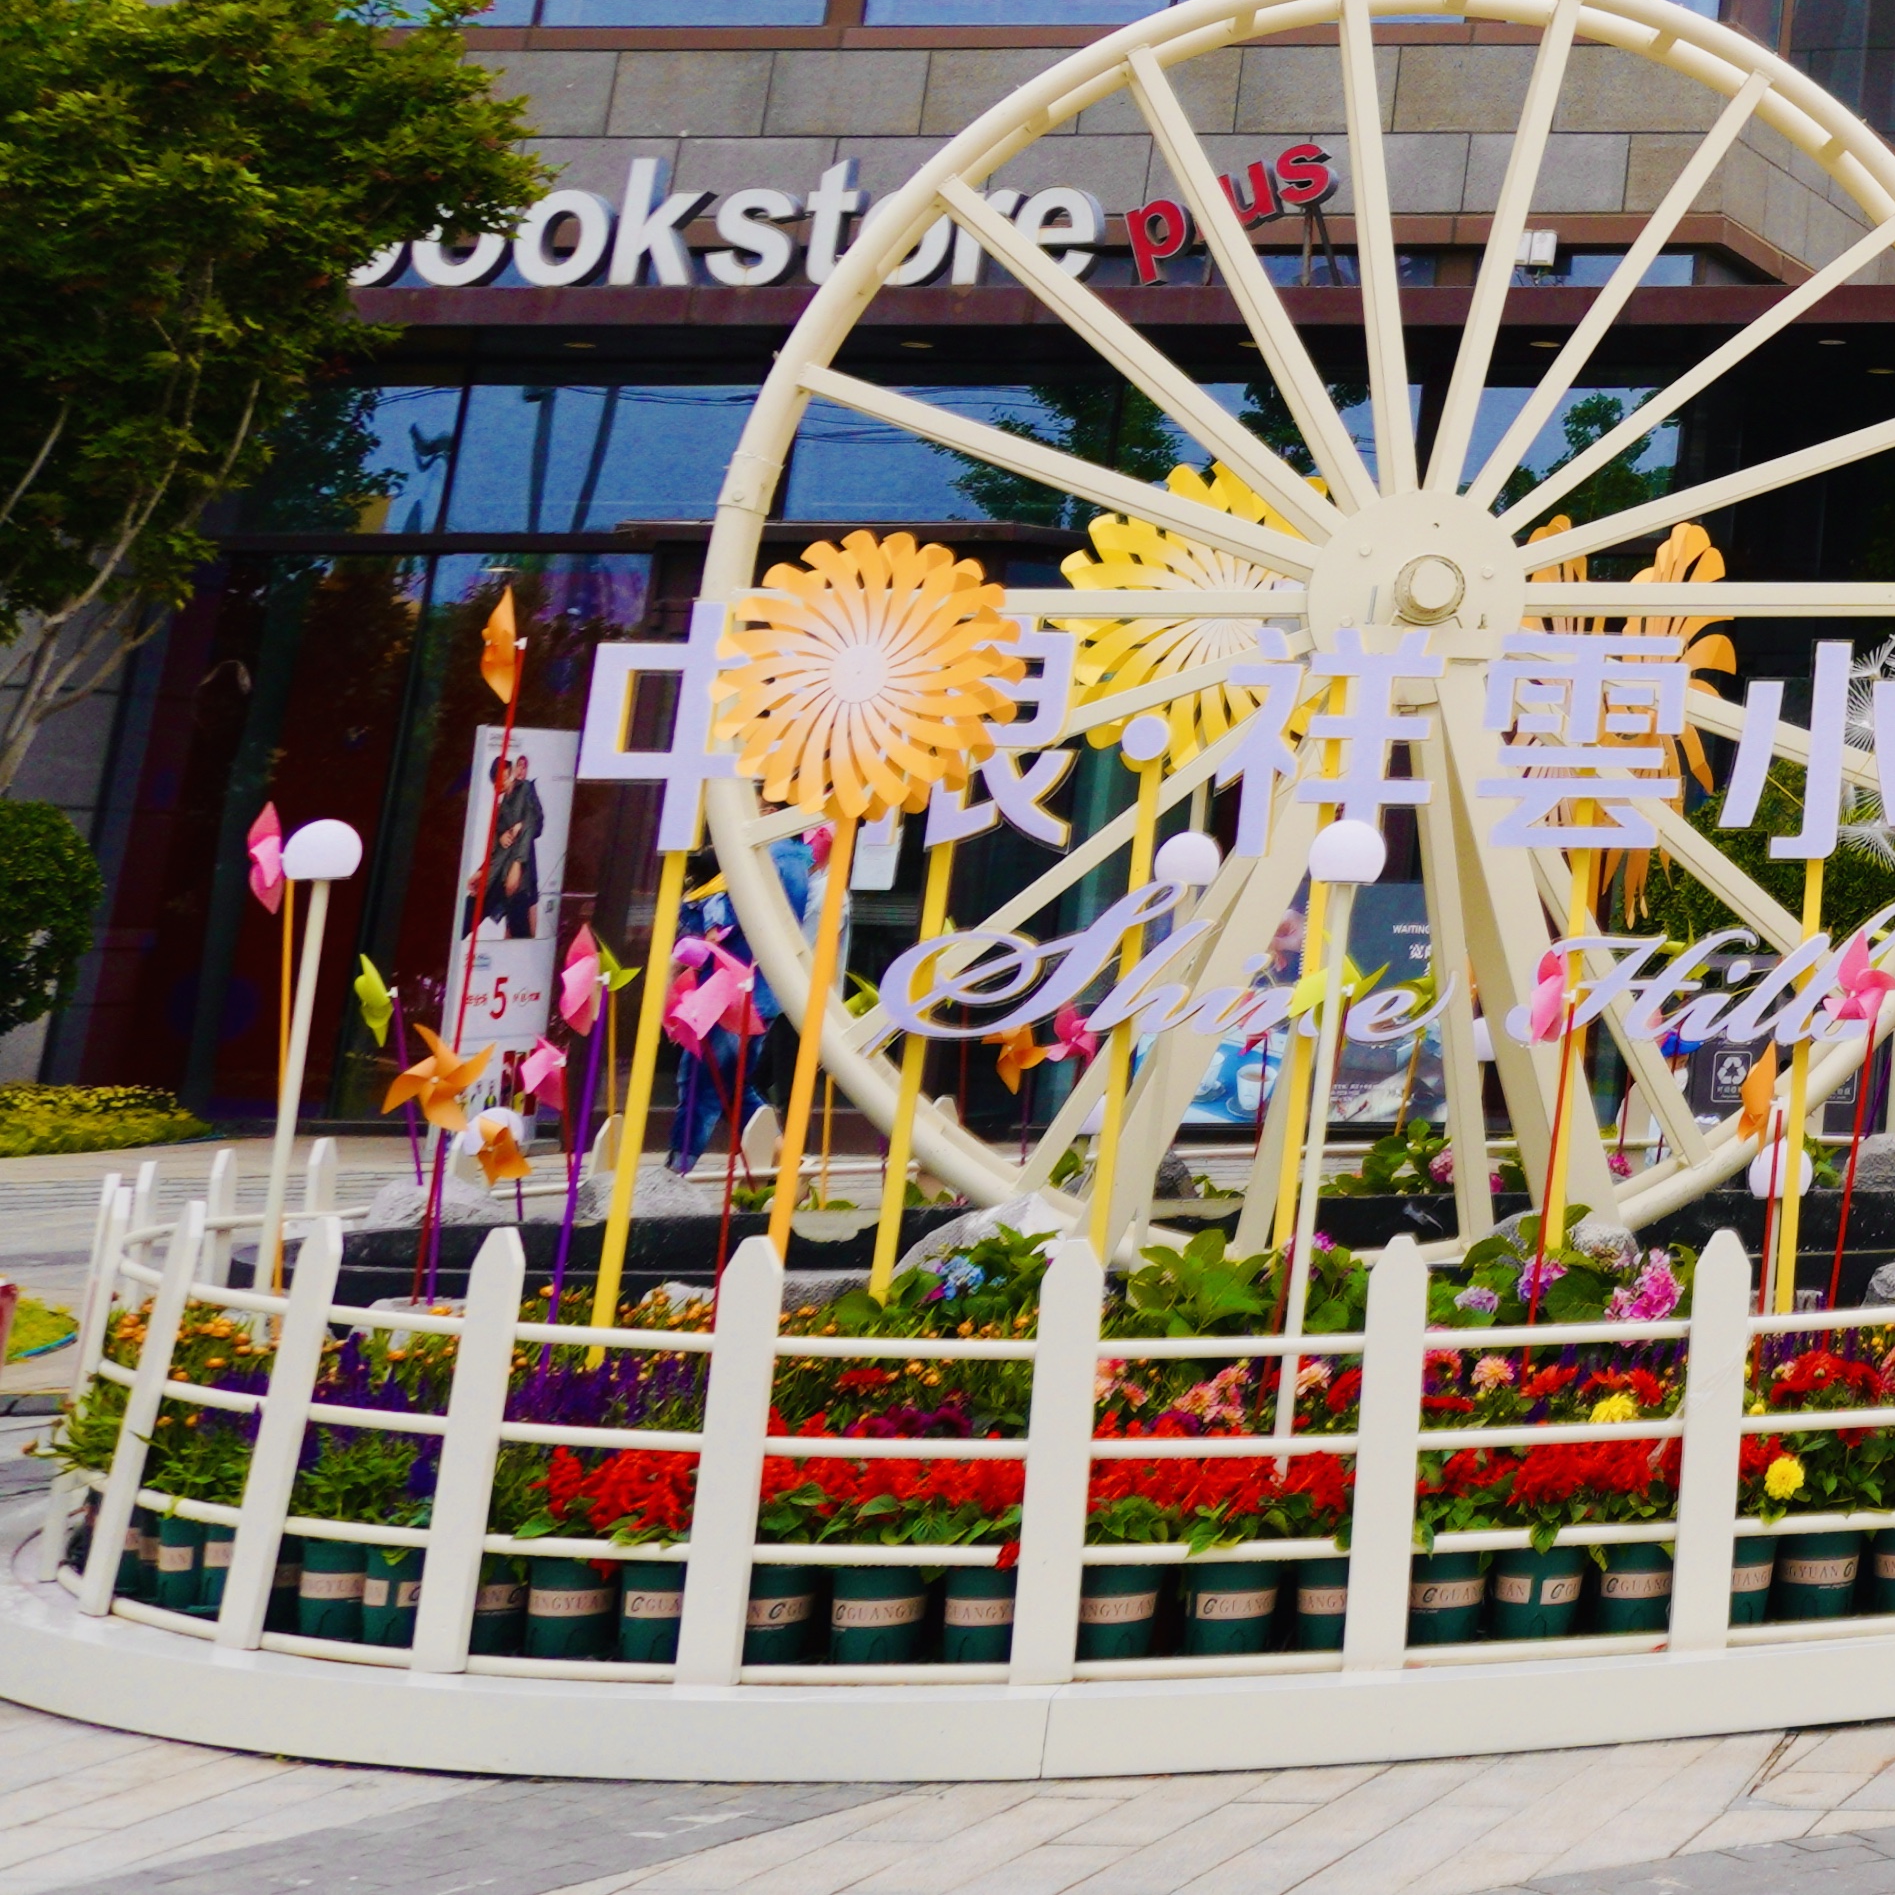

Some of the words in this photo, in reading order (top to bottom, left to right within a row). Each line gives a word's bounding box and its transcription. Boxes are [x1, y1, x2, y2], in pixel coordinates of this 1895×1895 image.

[345, 157, 1104, 288] ookstore
[1125, 143, 1337, 286] pus
[489, 977, 508, 1020] 5
